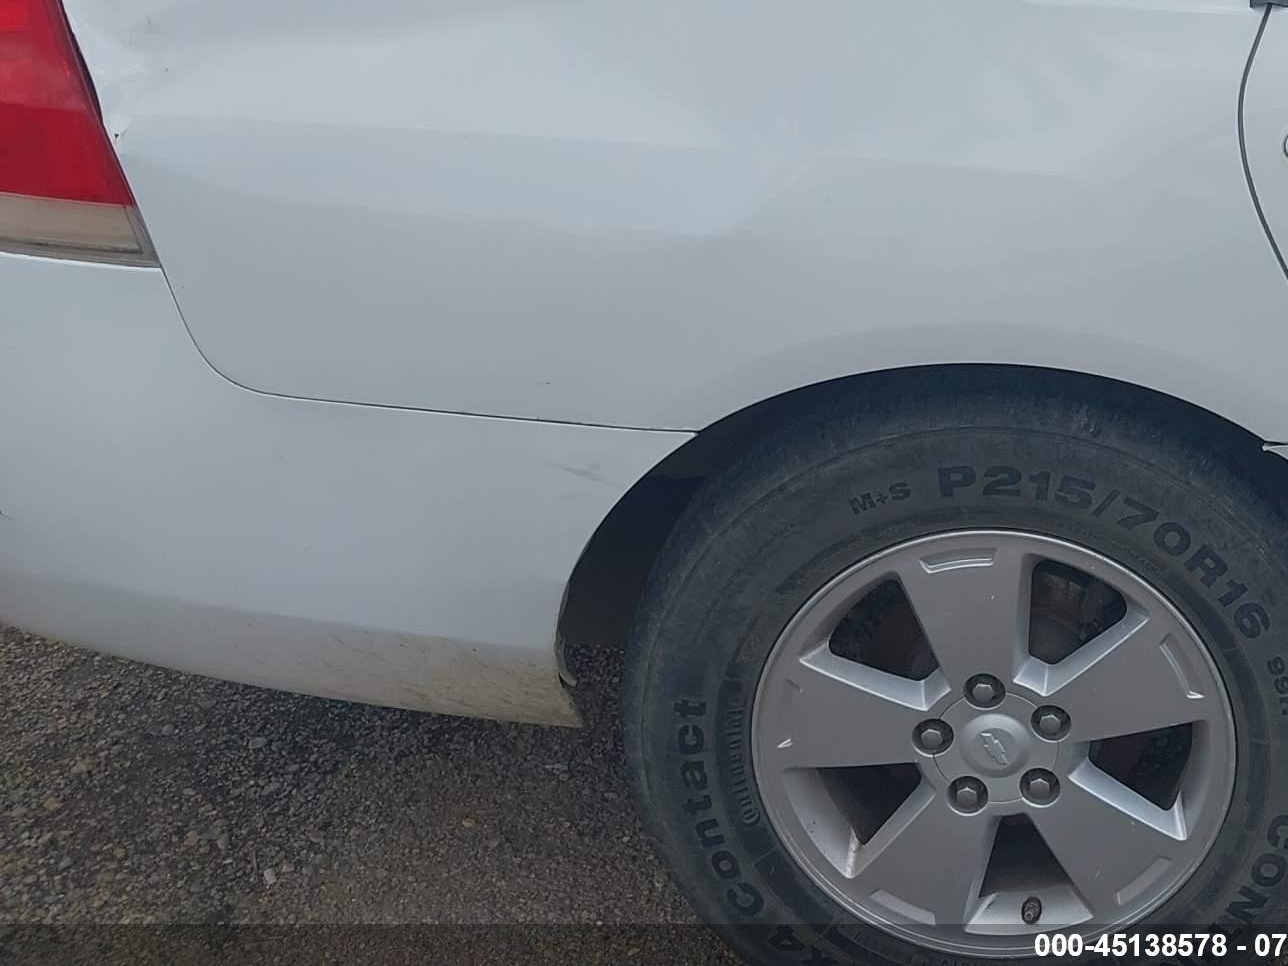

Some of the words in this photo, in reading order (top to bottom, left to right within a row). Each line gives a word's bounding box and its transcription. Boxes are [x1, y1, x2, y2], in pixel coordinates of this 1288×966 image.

[849, 481, 911, 516] M+S
[936, 465, 1272, 639] P215/70R16
[673, 697, 765, 916] Contact
